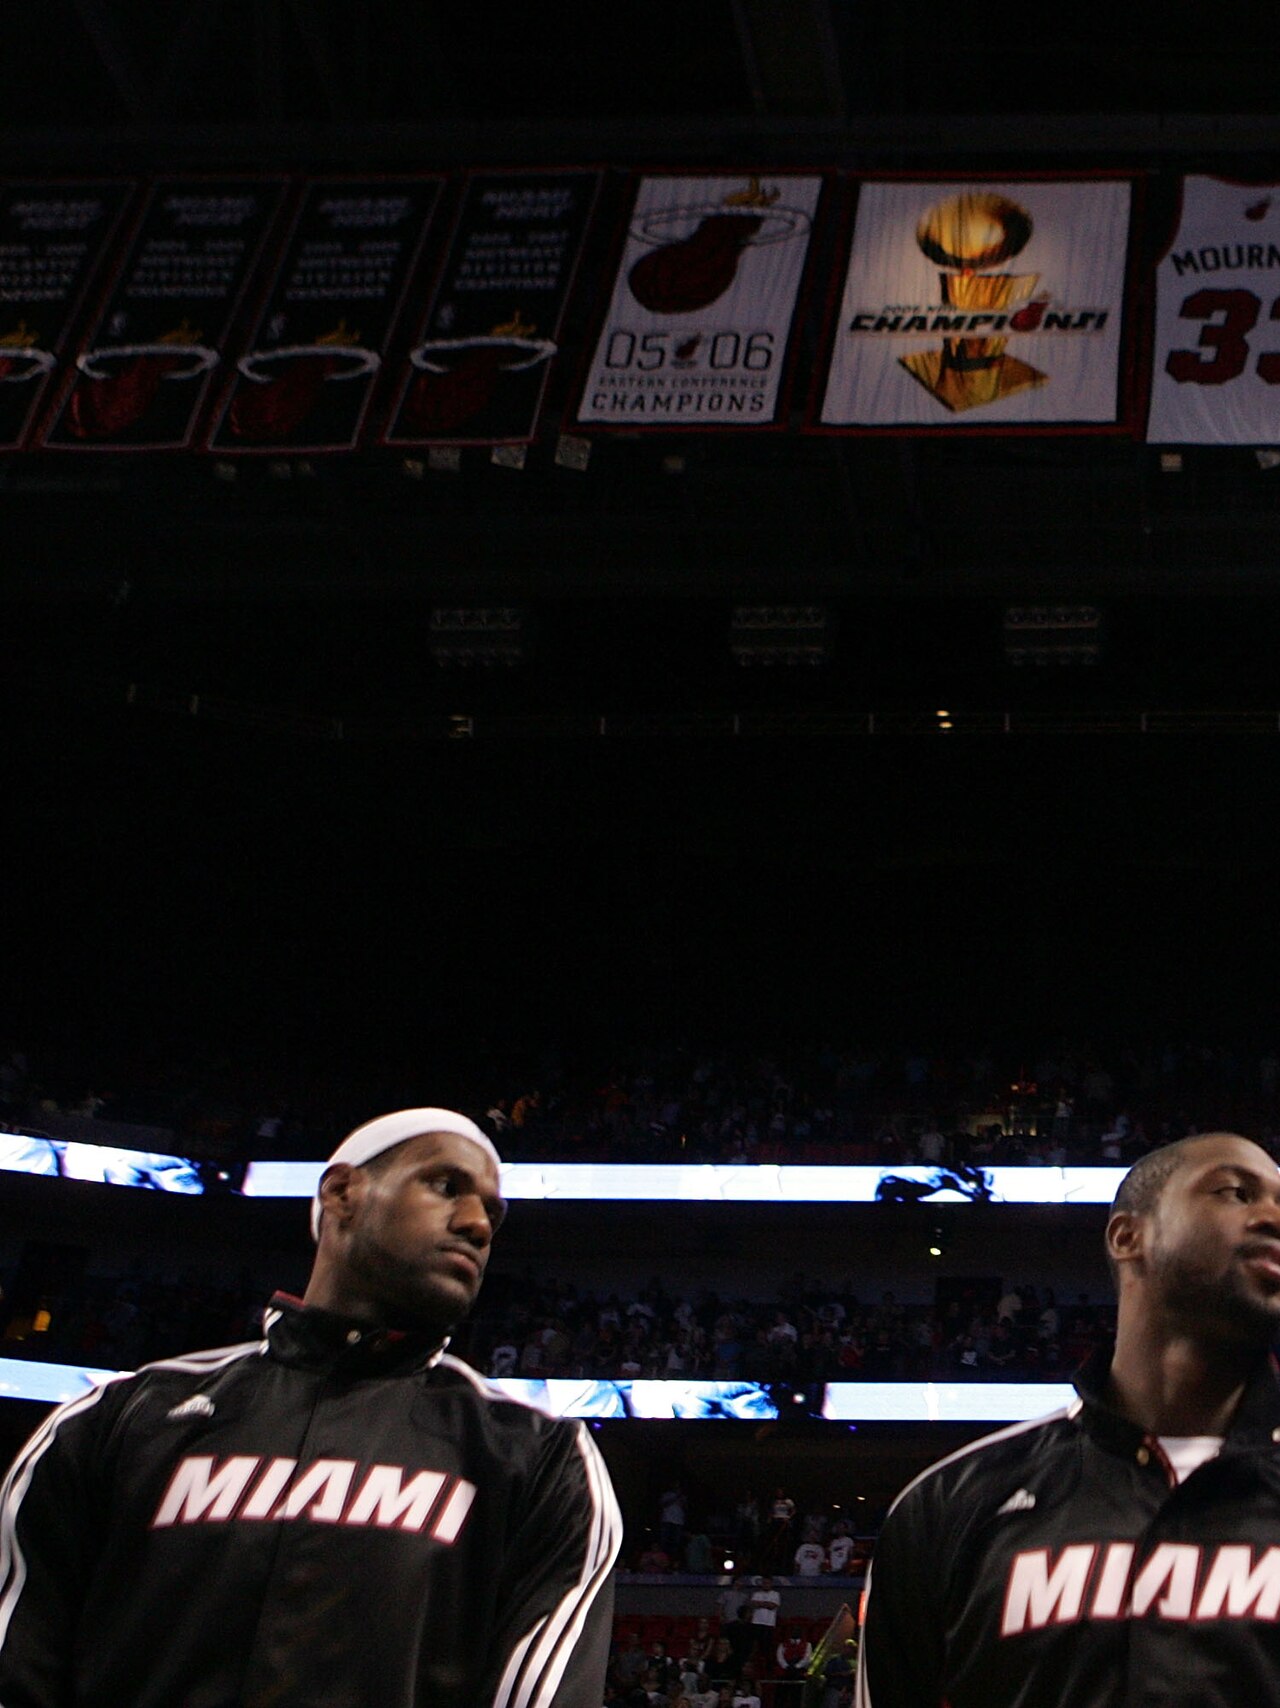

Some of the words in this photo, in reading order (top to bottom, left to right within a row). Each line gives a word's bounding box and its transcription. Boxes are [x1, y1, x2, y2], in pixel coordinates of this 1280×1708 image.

[605, 331, 671, 371] 05
[709, 331, 775, 371] 06
[591, 393, 766, 413] CHAMPIONS
[148, 1454, 481, 1546] MIAMI
